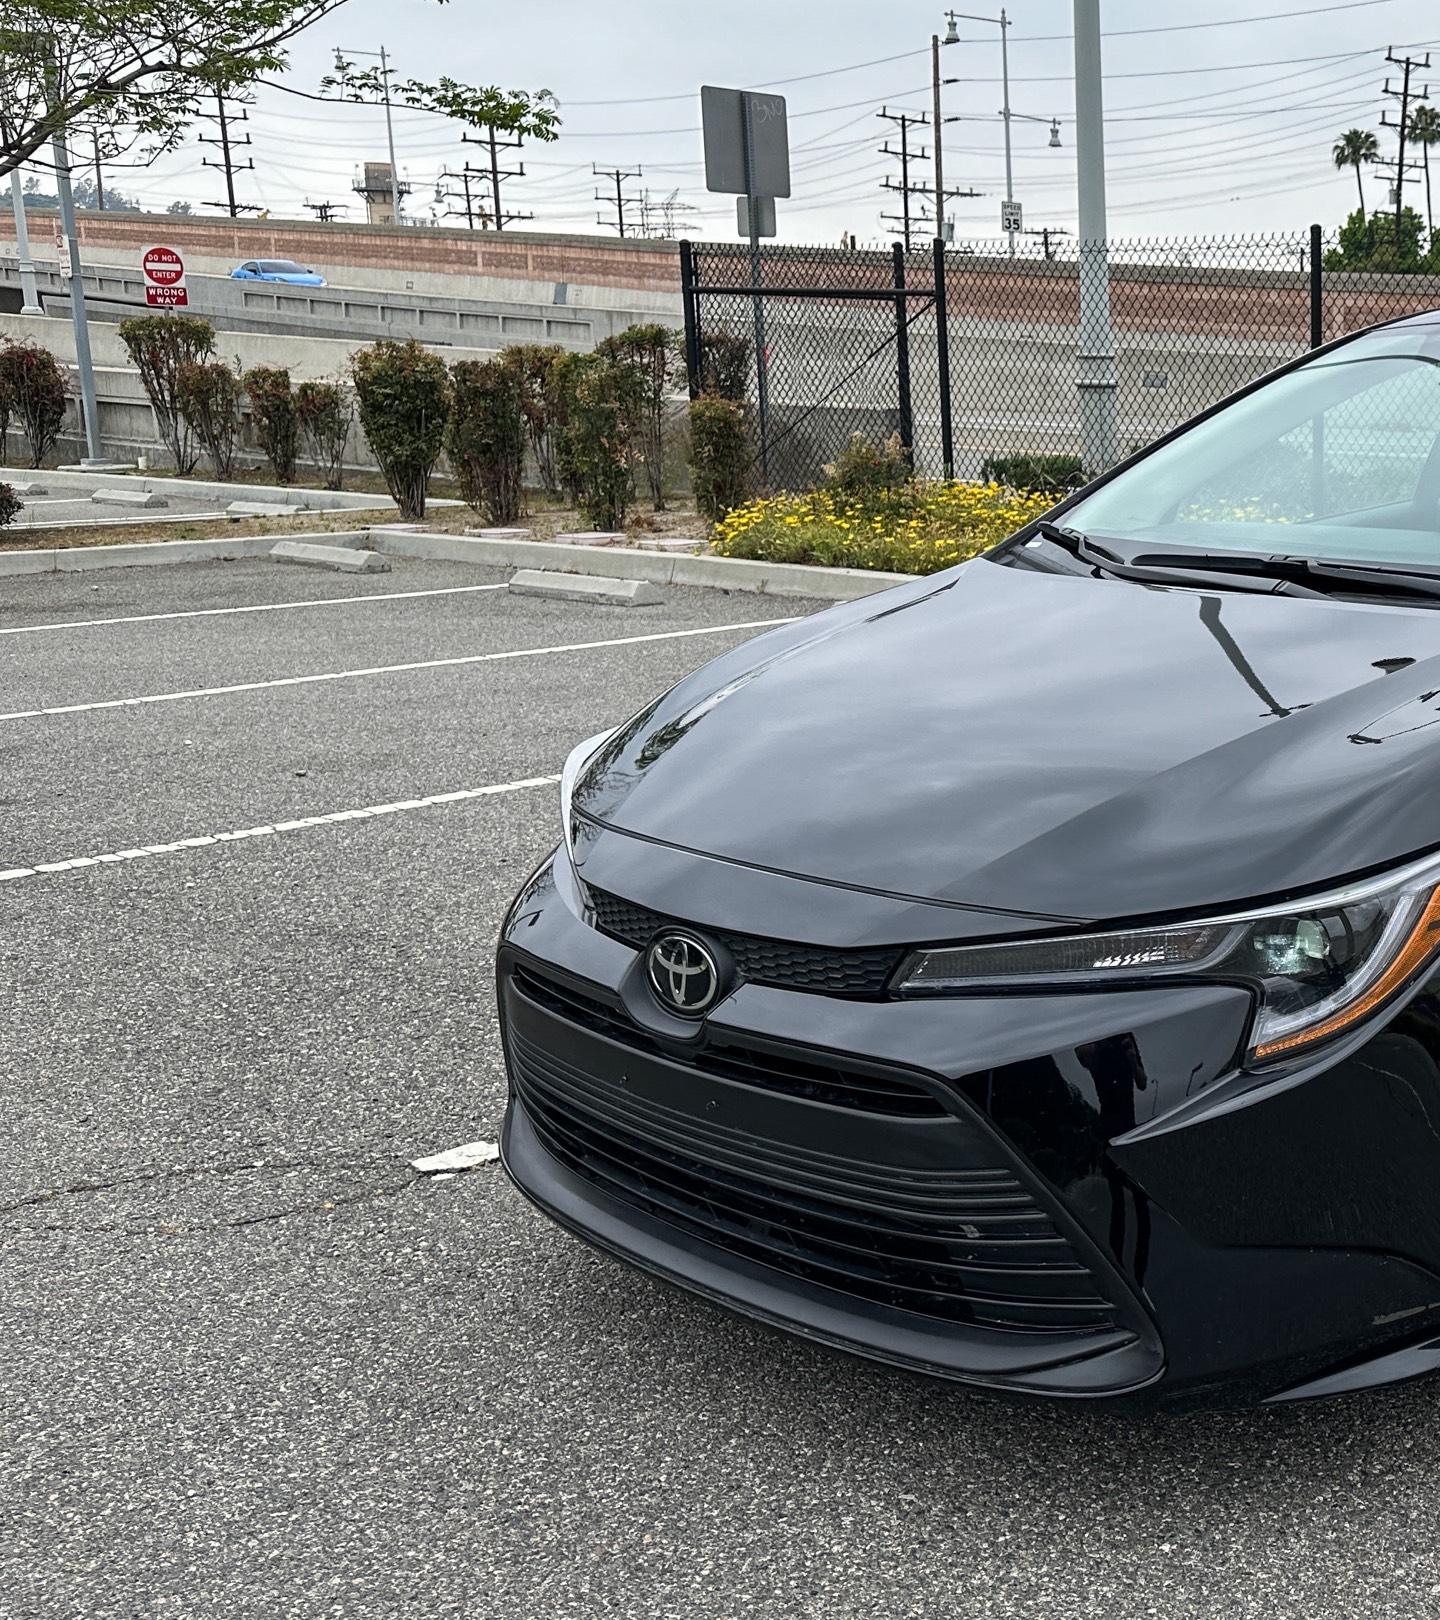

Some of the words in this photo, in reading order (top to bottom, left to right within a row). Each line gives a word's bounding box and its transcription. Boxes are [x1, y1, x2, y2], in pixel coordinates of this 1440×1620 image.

[1004, 218, 1020, 230] 35
[147, 253, 159, 261] DO
[161, 254, 177, 262] NOT
[152, 271, 176, 279] ENTER
[148, 287, 185, 296] WRONG
[156, 296, 178, 304] WAY
